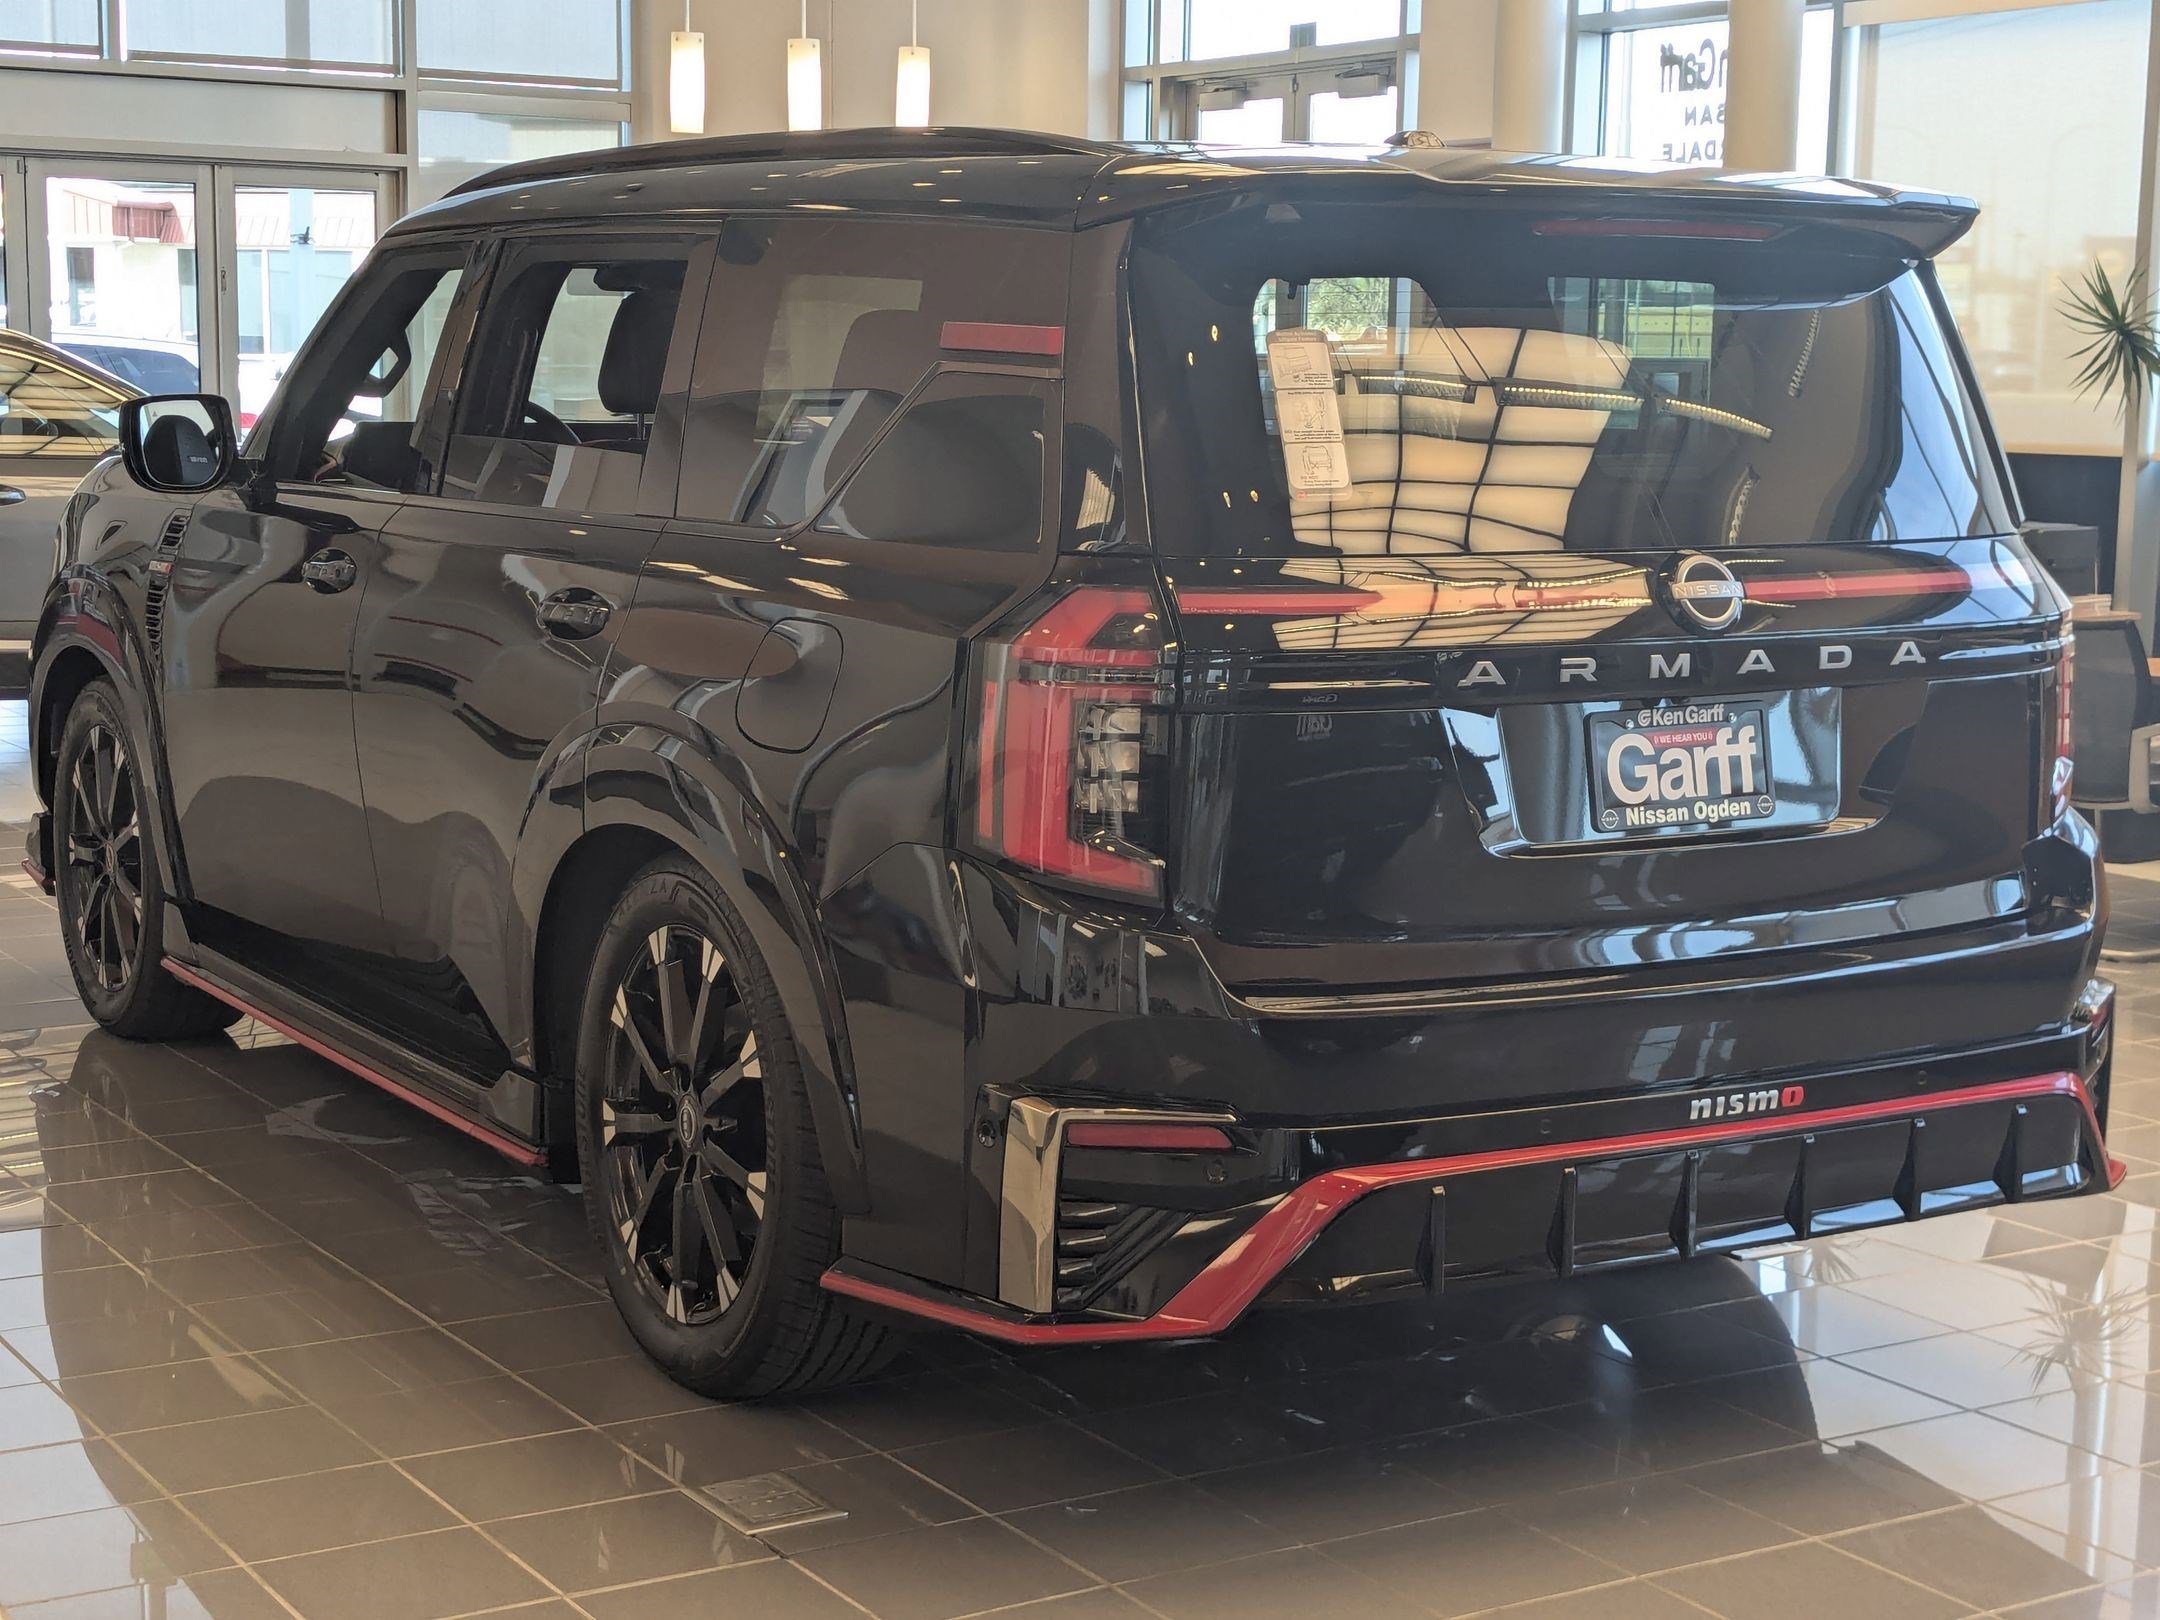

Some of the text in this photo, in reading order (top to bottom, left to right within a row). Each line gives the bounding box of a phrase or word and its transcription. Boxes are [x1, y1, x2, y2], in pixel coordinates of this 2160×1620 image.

[1674, 583, 1743, 598] NISSAN
[1457, 641, 1926, 687] ARMADA
[1685, 704, 1724, 724] Garff
[1607, 725, 1757, 805] Garff
[1625, 800, 1751, 826] Nissan Ogden
[1689, 1086, 1804, 1120] nismo
